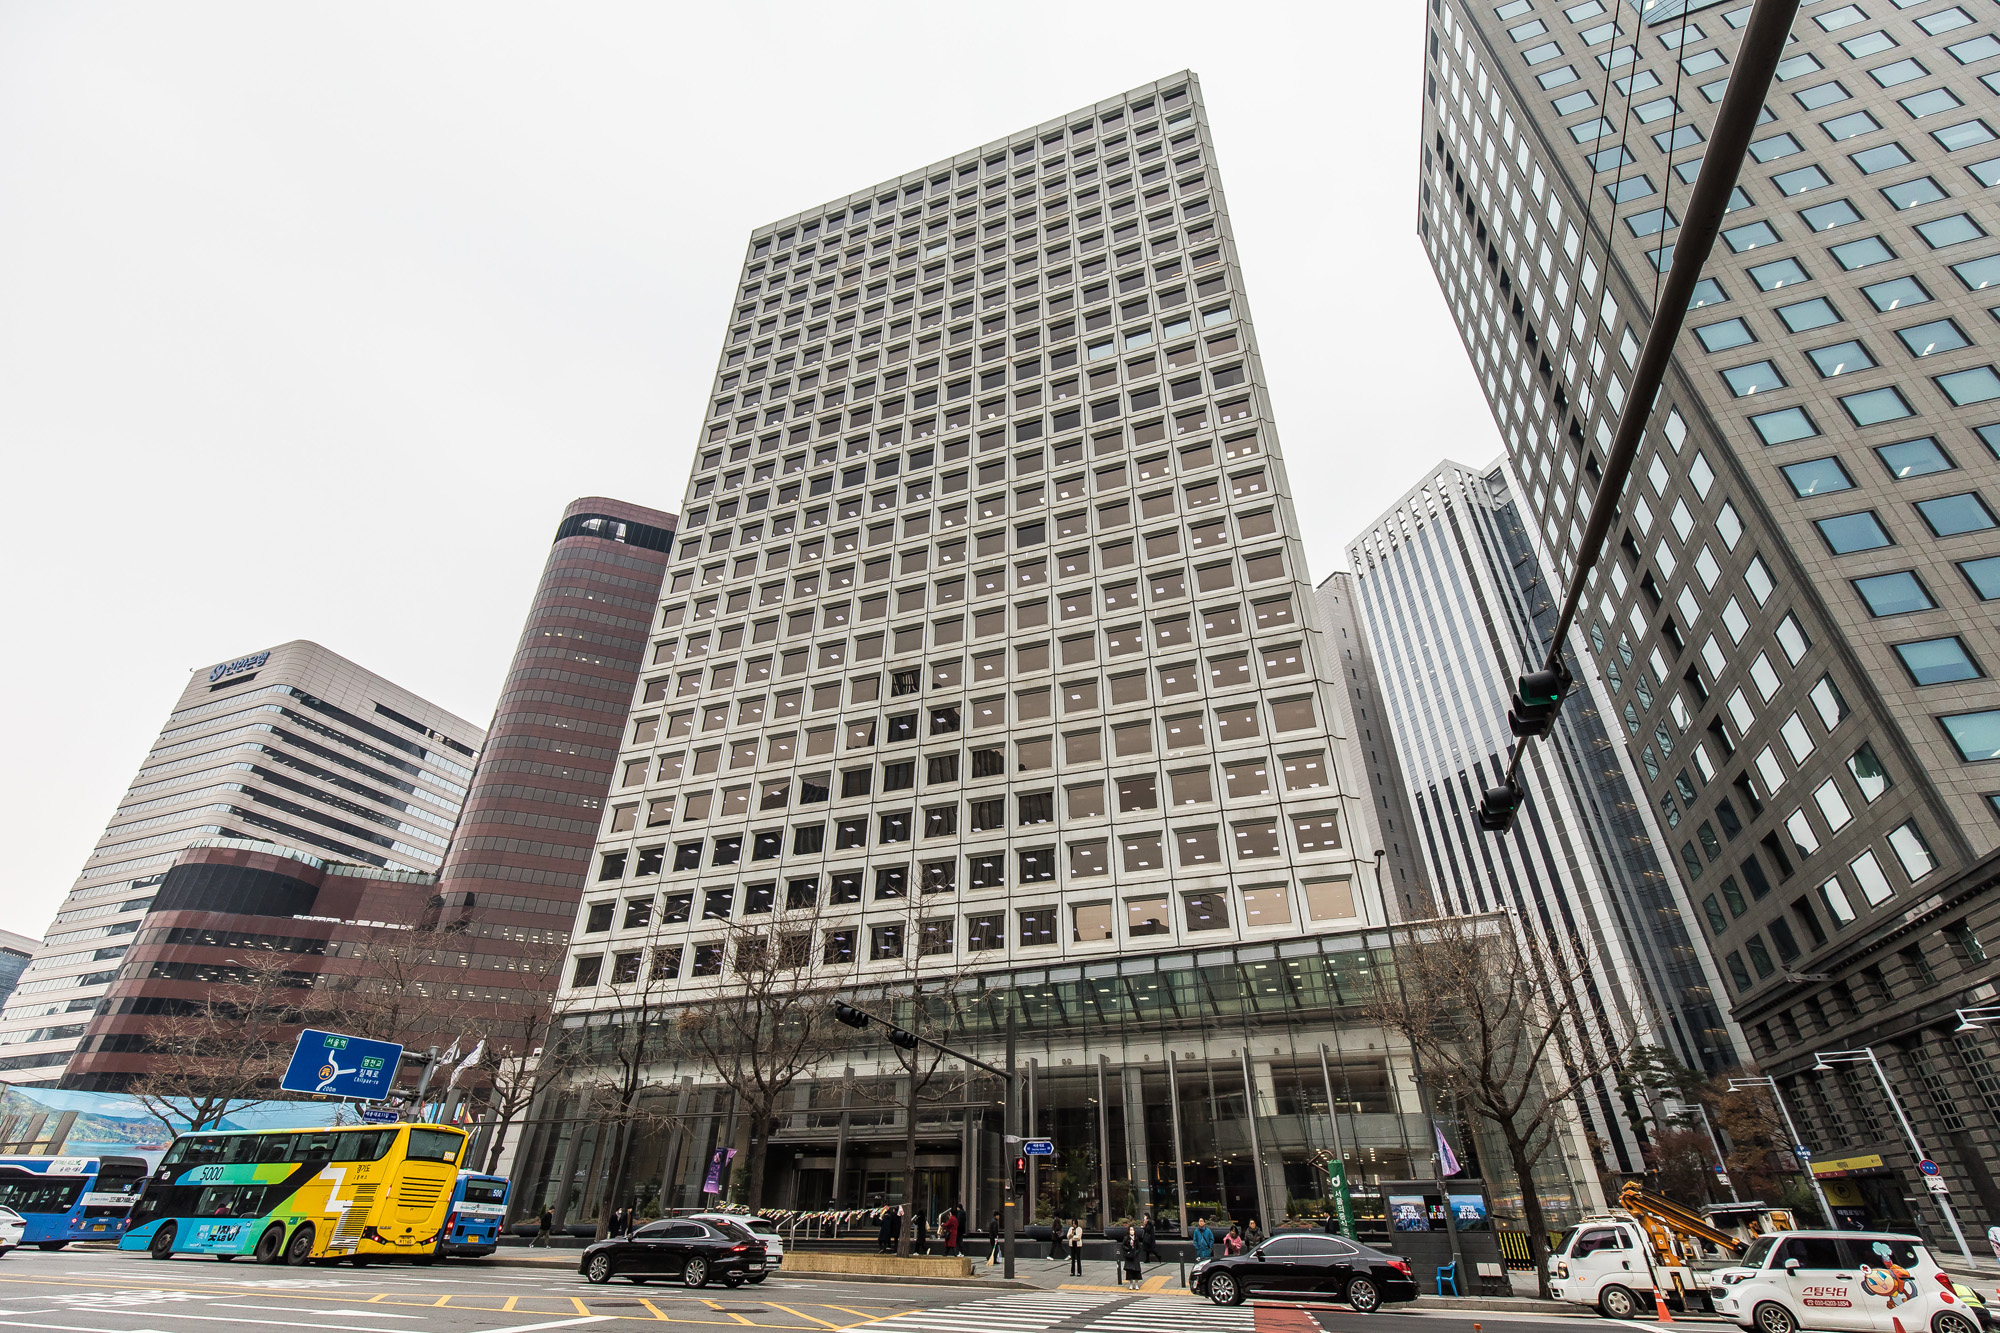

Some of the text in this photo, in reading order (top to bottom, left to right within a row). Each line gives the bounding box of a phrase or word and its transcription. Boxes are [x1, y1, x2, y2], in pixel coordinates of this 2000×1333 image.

[225, 651, 270, 676] 신한은행
[327, 1038, 346, 1048] 서울역
[359, 1069, 379, 1078] 칠패로
[444, 1152, 454, 1160] 5000
[200, 1167, 224, 1180] 5000
[357, 1165, 371, 1173] 경기도
[493, 1189, 502, 1197] 500
[1802, 1287, 1847, 1297] 스팀닥터
